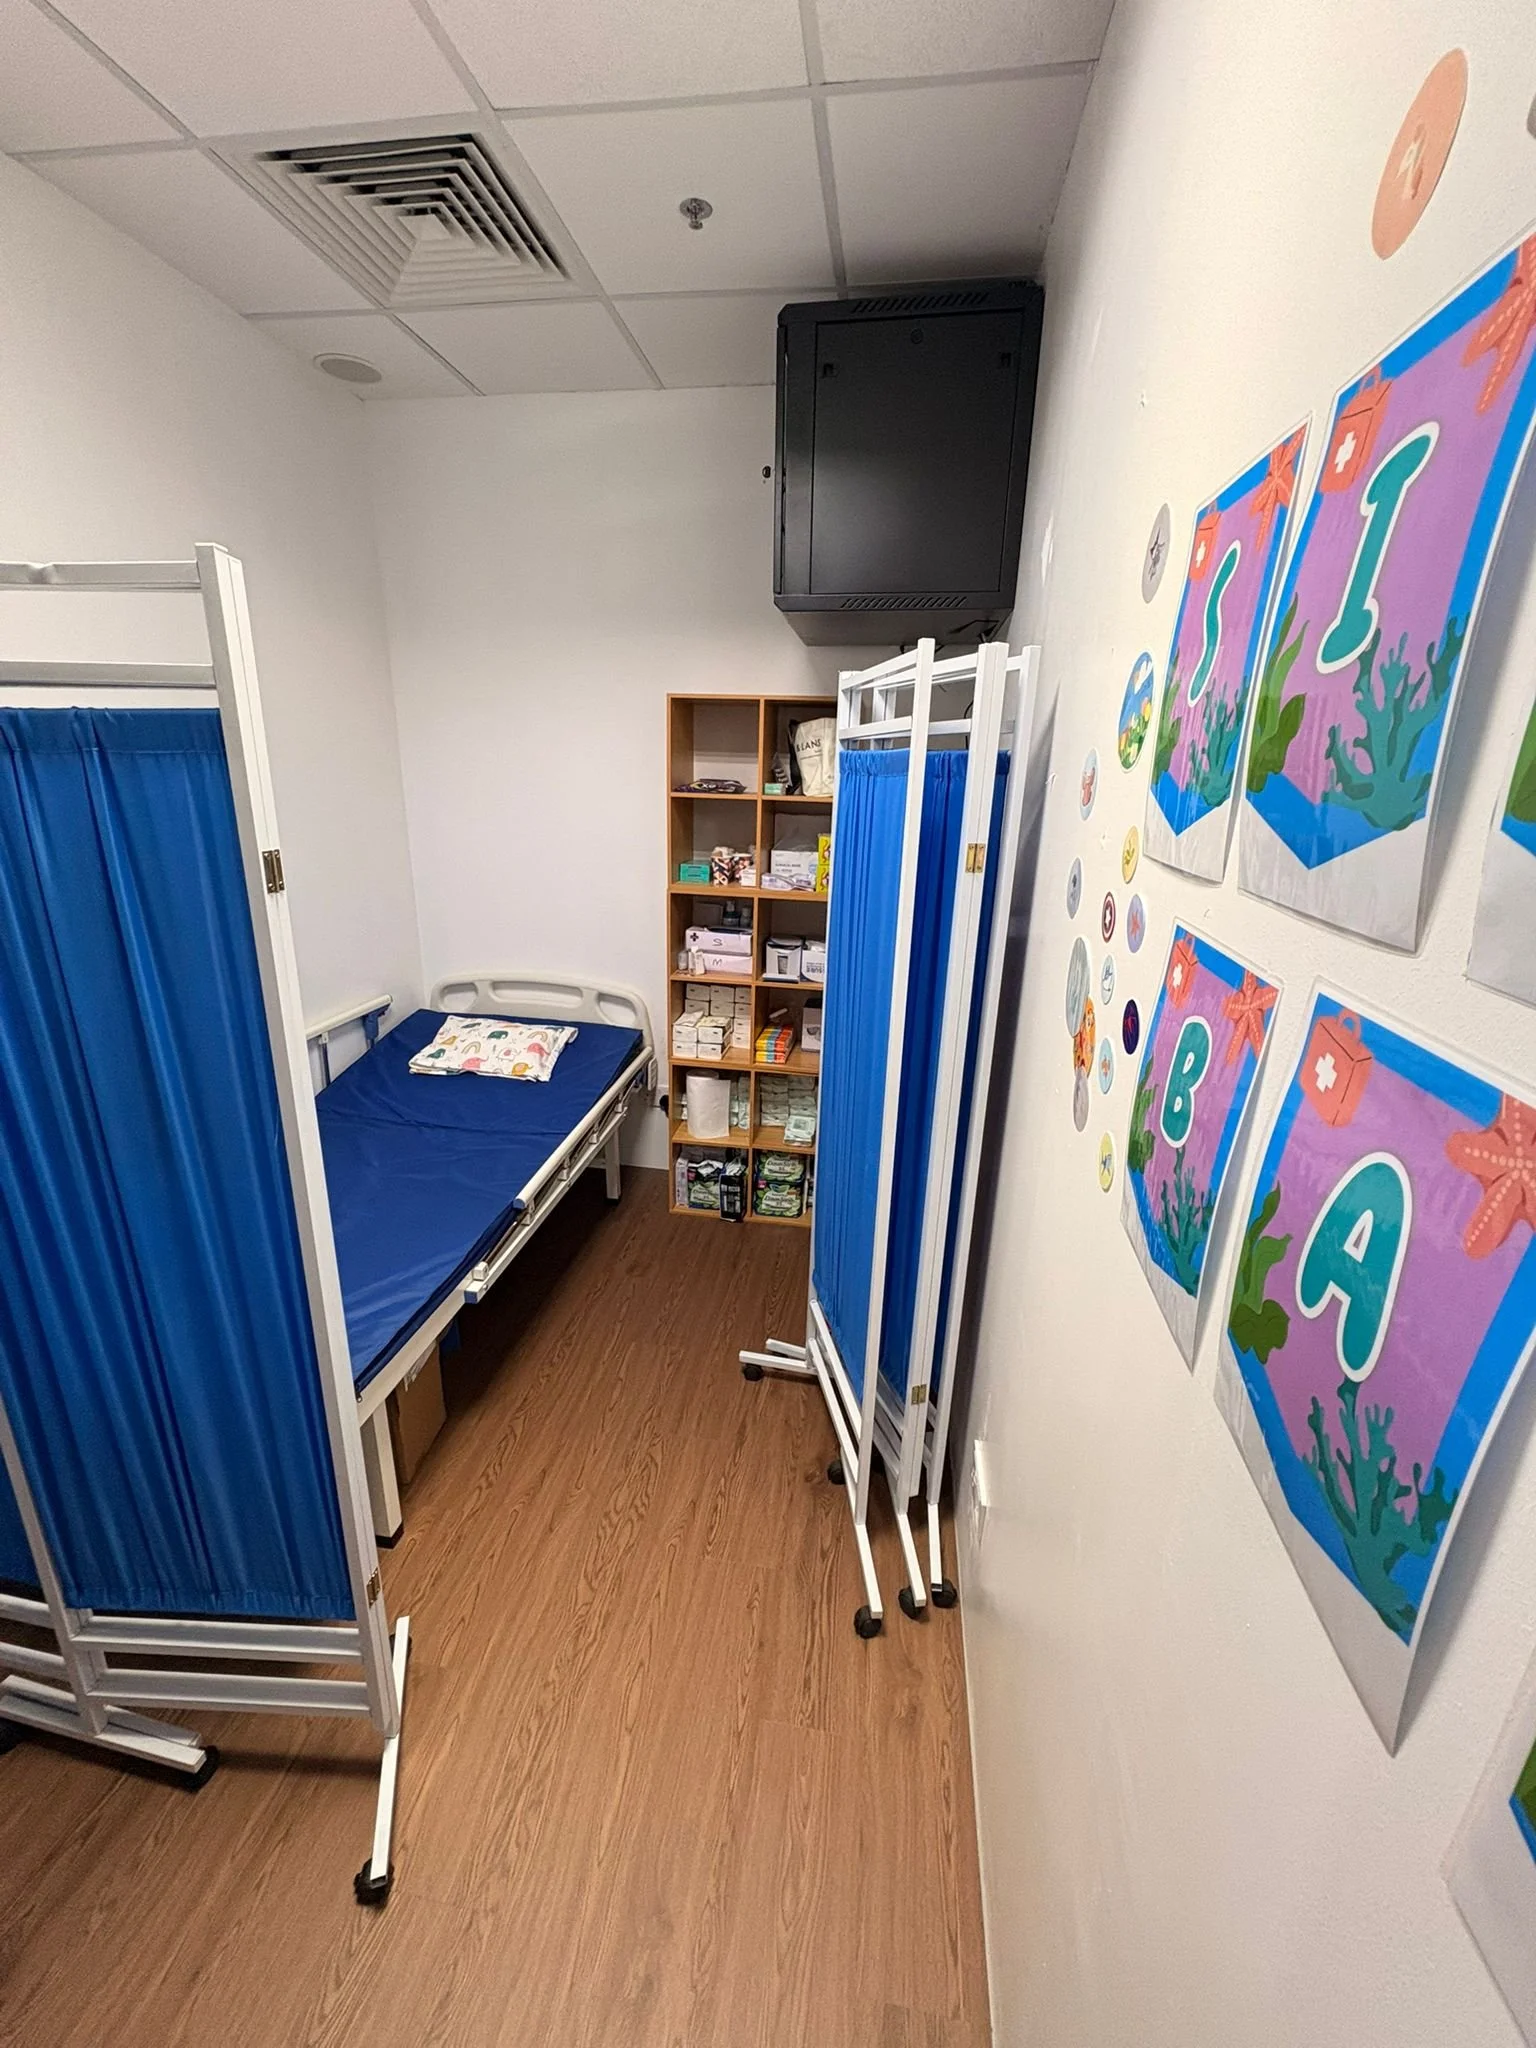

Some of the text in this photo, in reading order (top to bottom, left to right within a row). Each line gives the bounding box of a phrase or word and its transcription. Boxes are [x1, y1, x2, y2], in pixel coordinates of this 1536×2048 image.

[1316, 421, 1440, 673] I
[1160, 1015, 1413, 1382] B A
